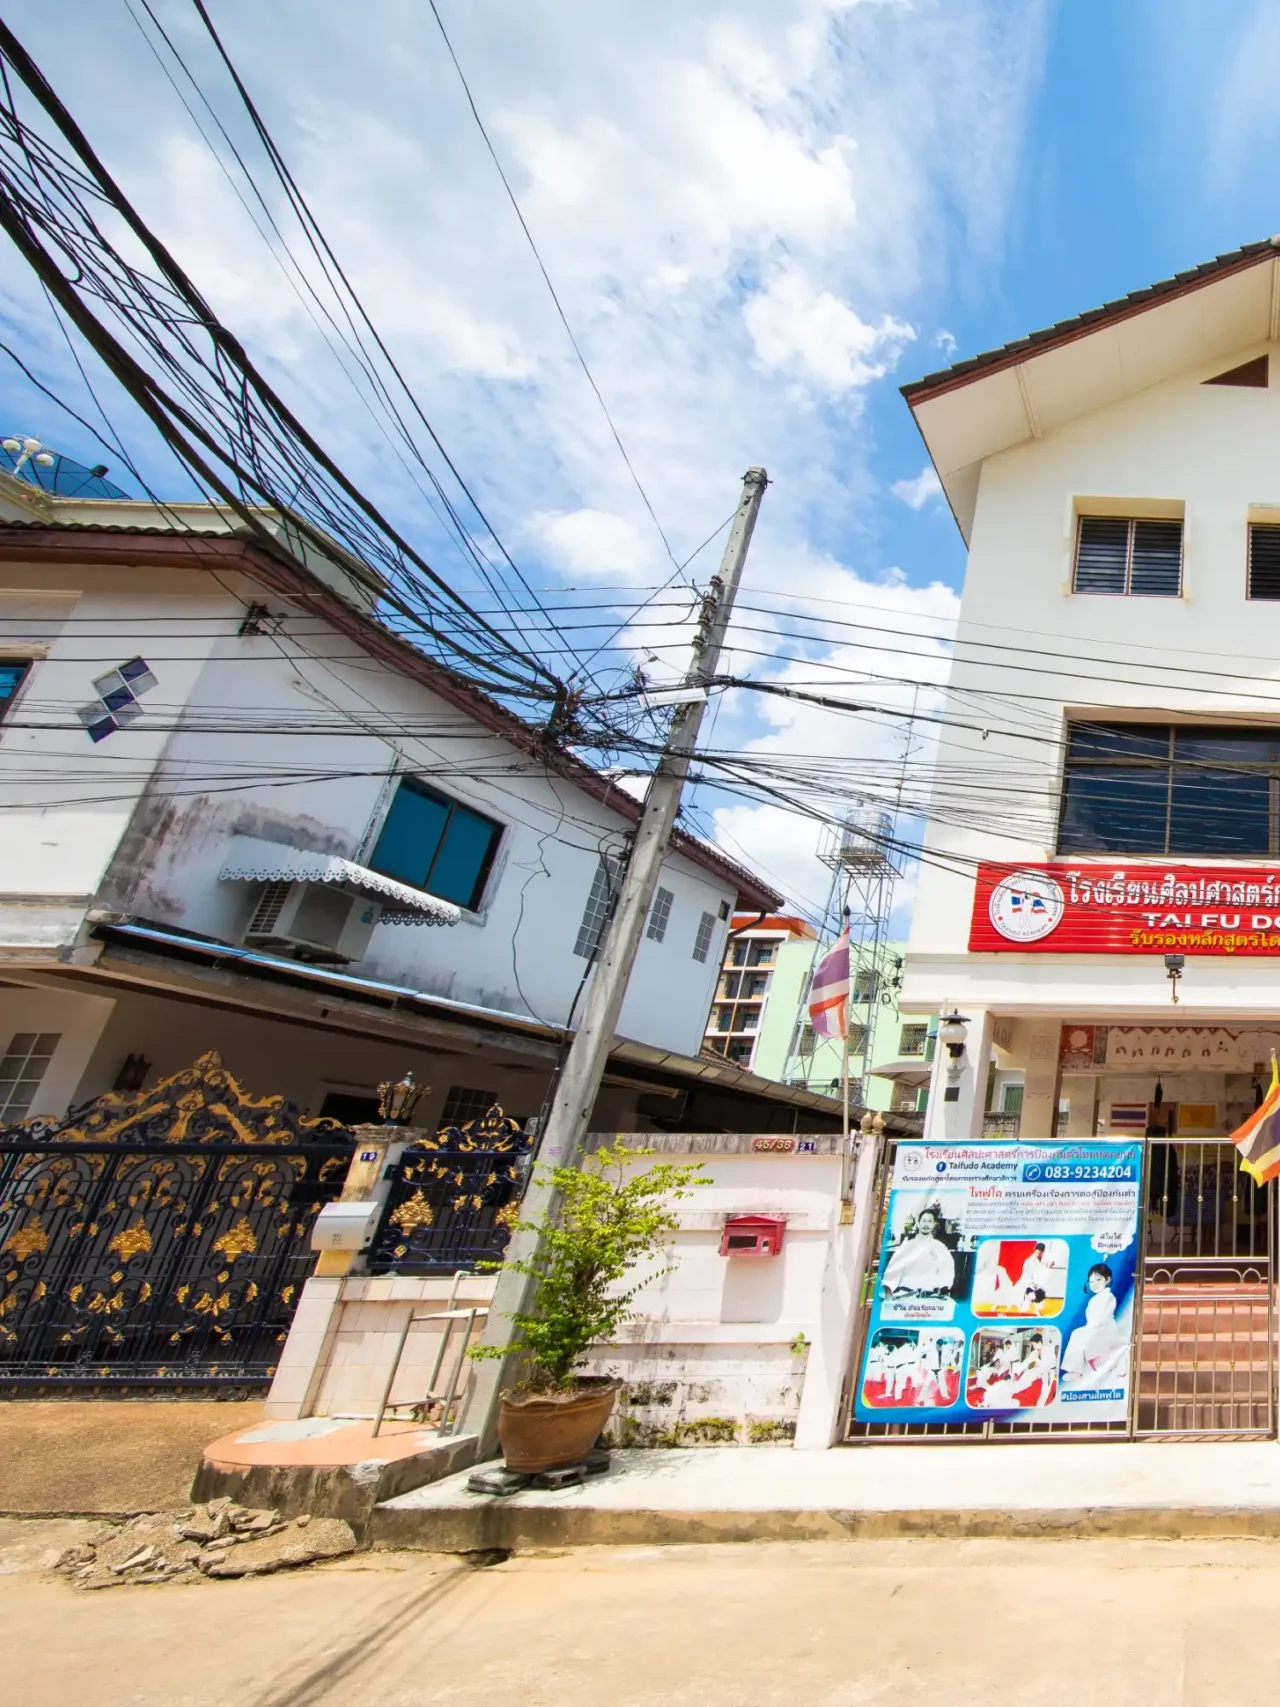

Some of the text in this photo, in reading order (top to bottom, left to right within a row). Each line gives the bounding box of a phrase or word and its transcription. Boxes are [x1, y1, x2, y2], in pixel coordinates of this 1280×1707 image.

[1142, 913, 1190, 928] TAI
[1201, 914, 1241, 929] FU
[756, 1140, 792, 1149] 45/38
[362, 1152, 376, 1160] 19
[949, 1162, 1018, 1171] Taifudo Academy
[1045, 1166, 1132, 1179] 083-9234204
